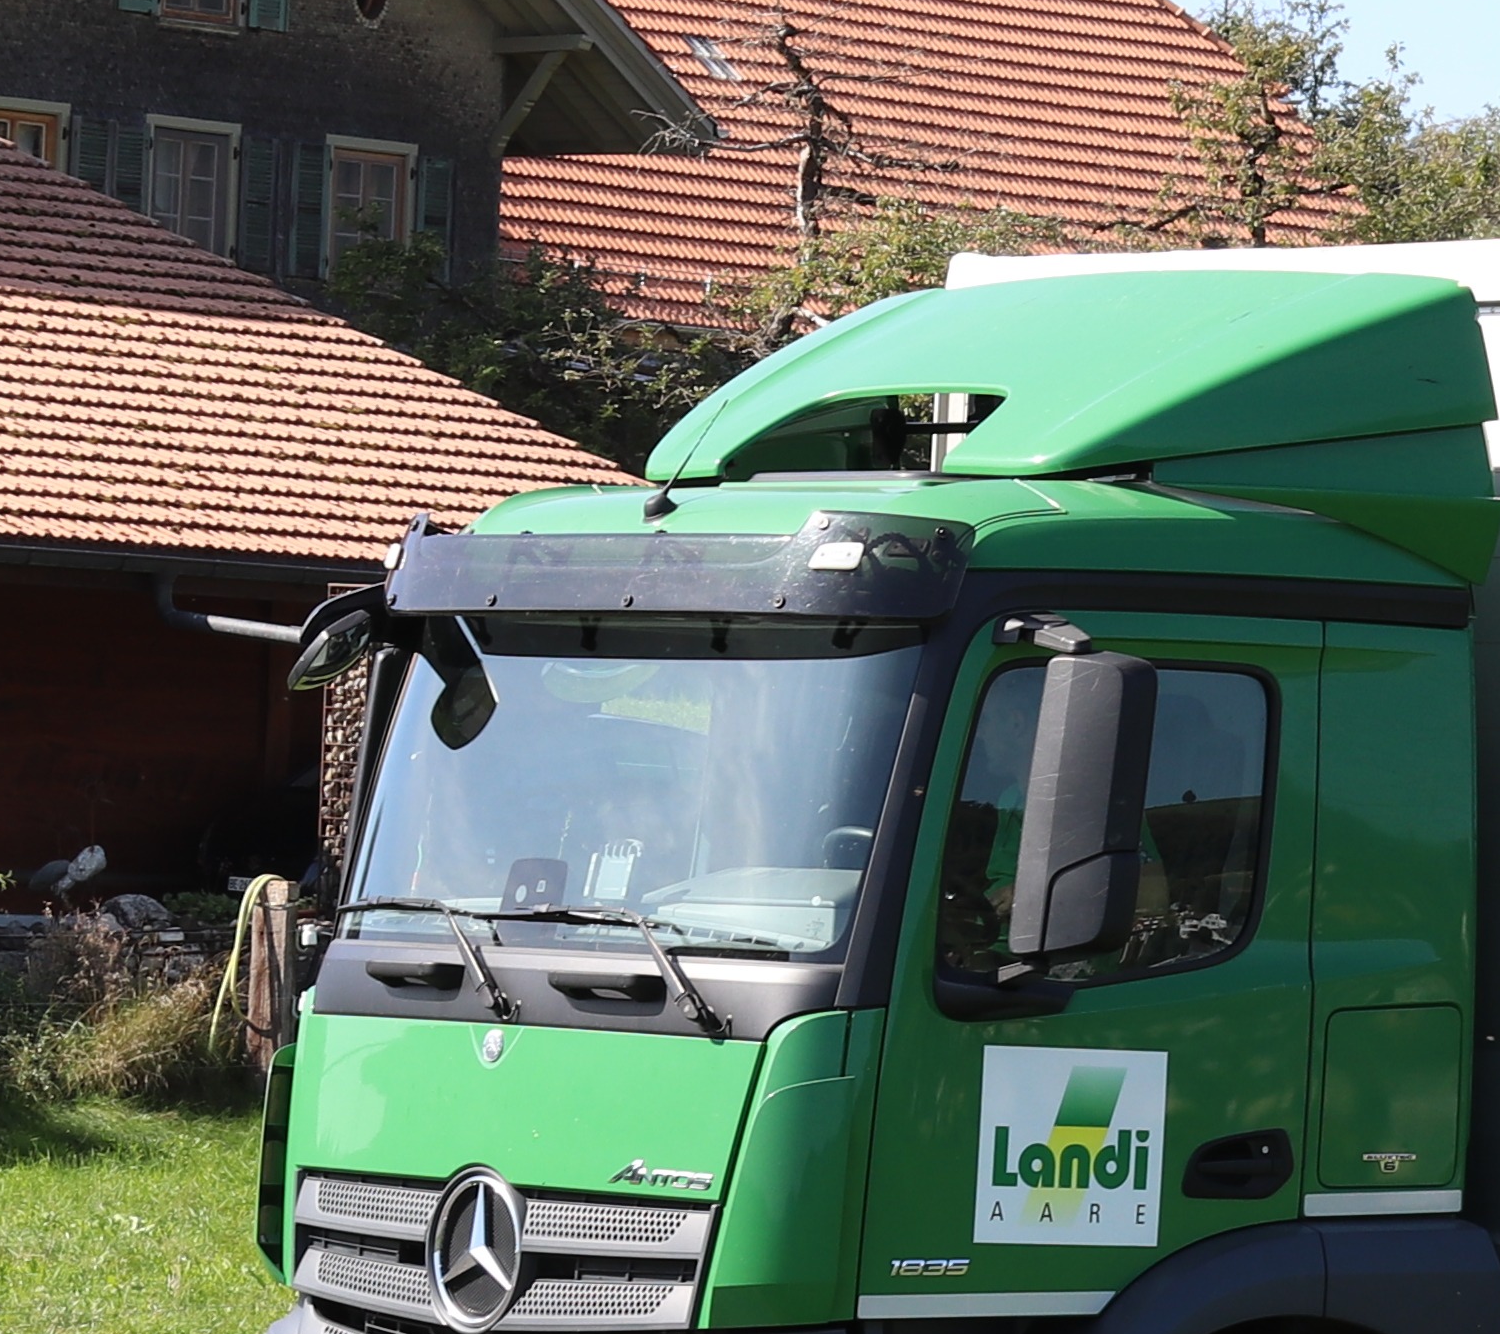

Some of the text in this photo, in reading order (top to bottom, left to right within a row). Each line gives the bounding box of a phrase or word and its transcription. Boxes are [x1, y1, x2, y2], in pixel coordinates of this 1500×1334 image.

[991, 1125, 1150, 1190] Landi
[989, 1201, 1147, 1225] AARE
[890, 1259, 971, 1277] 1835
